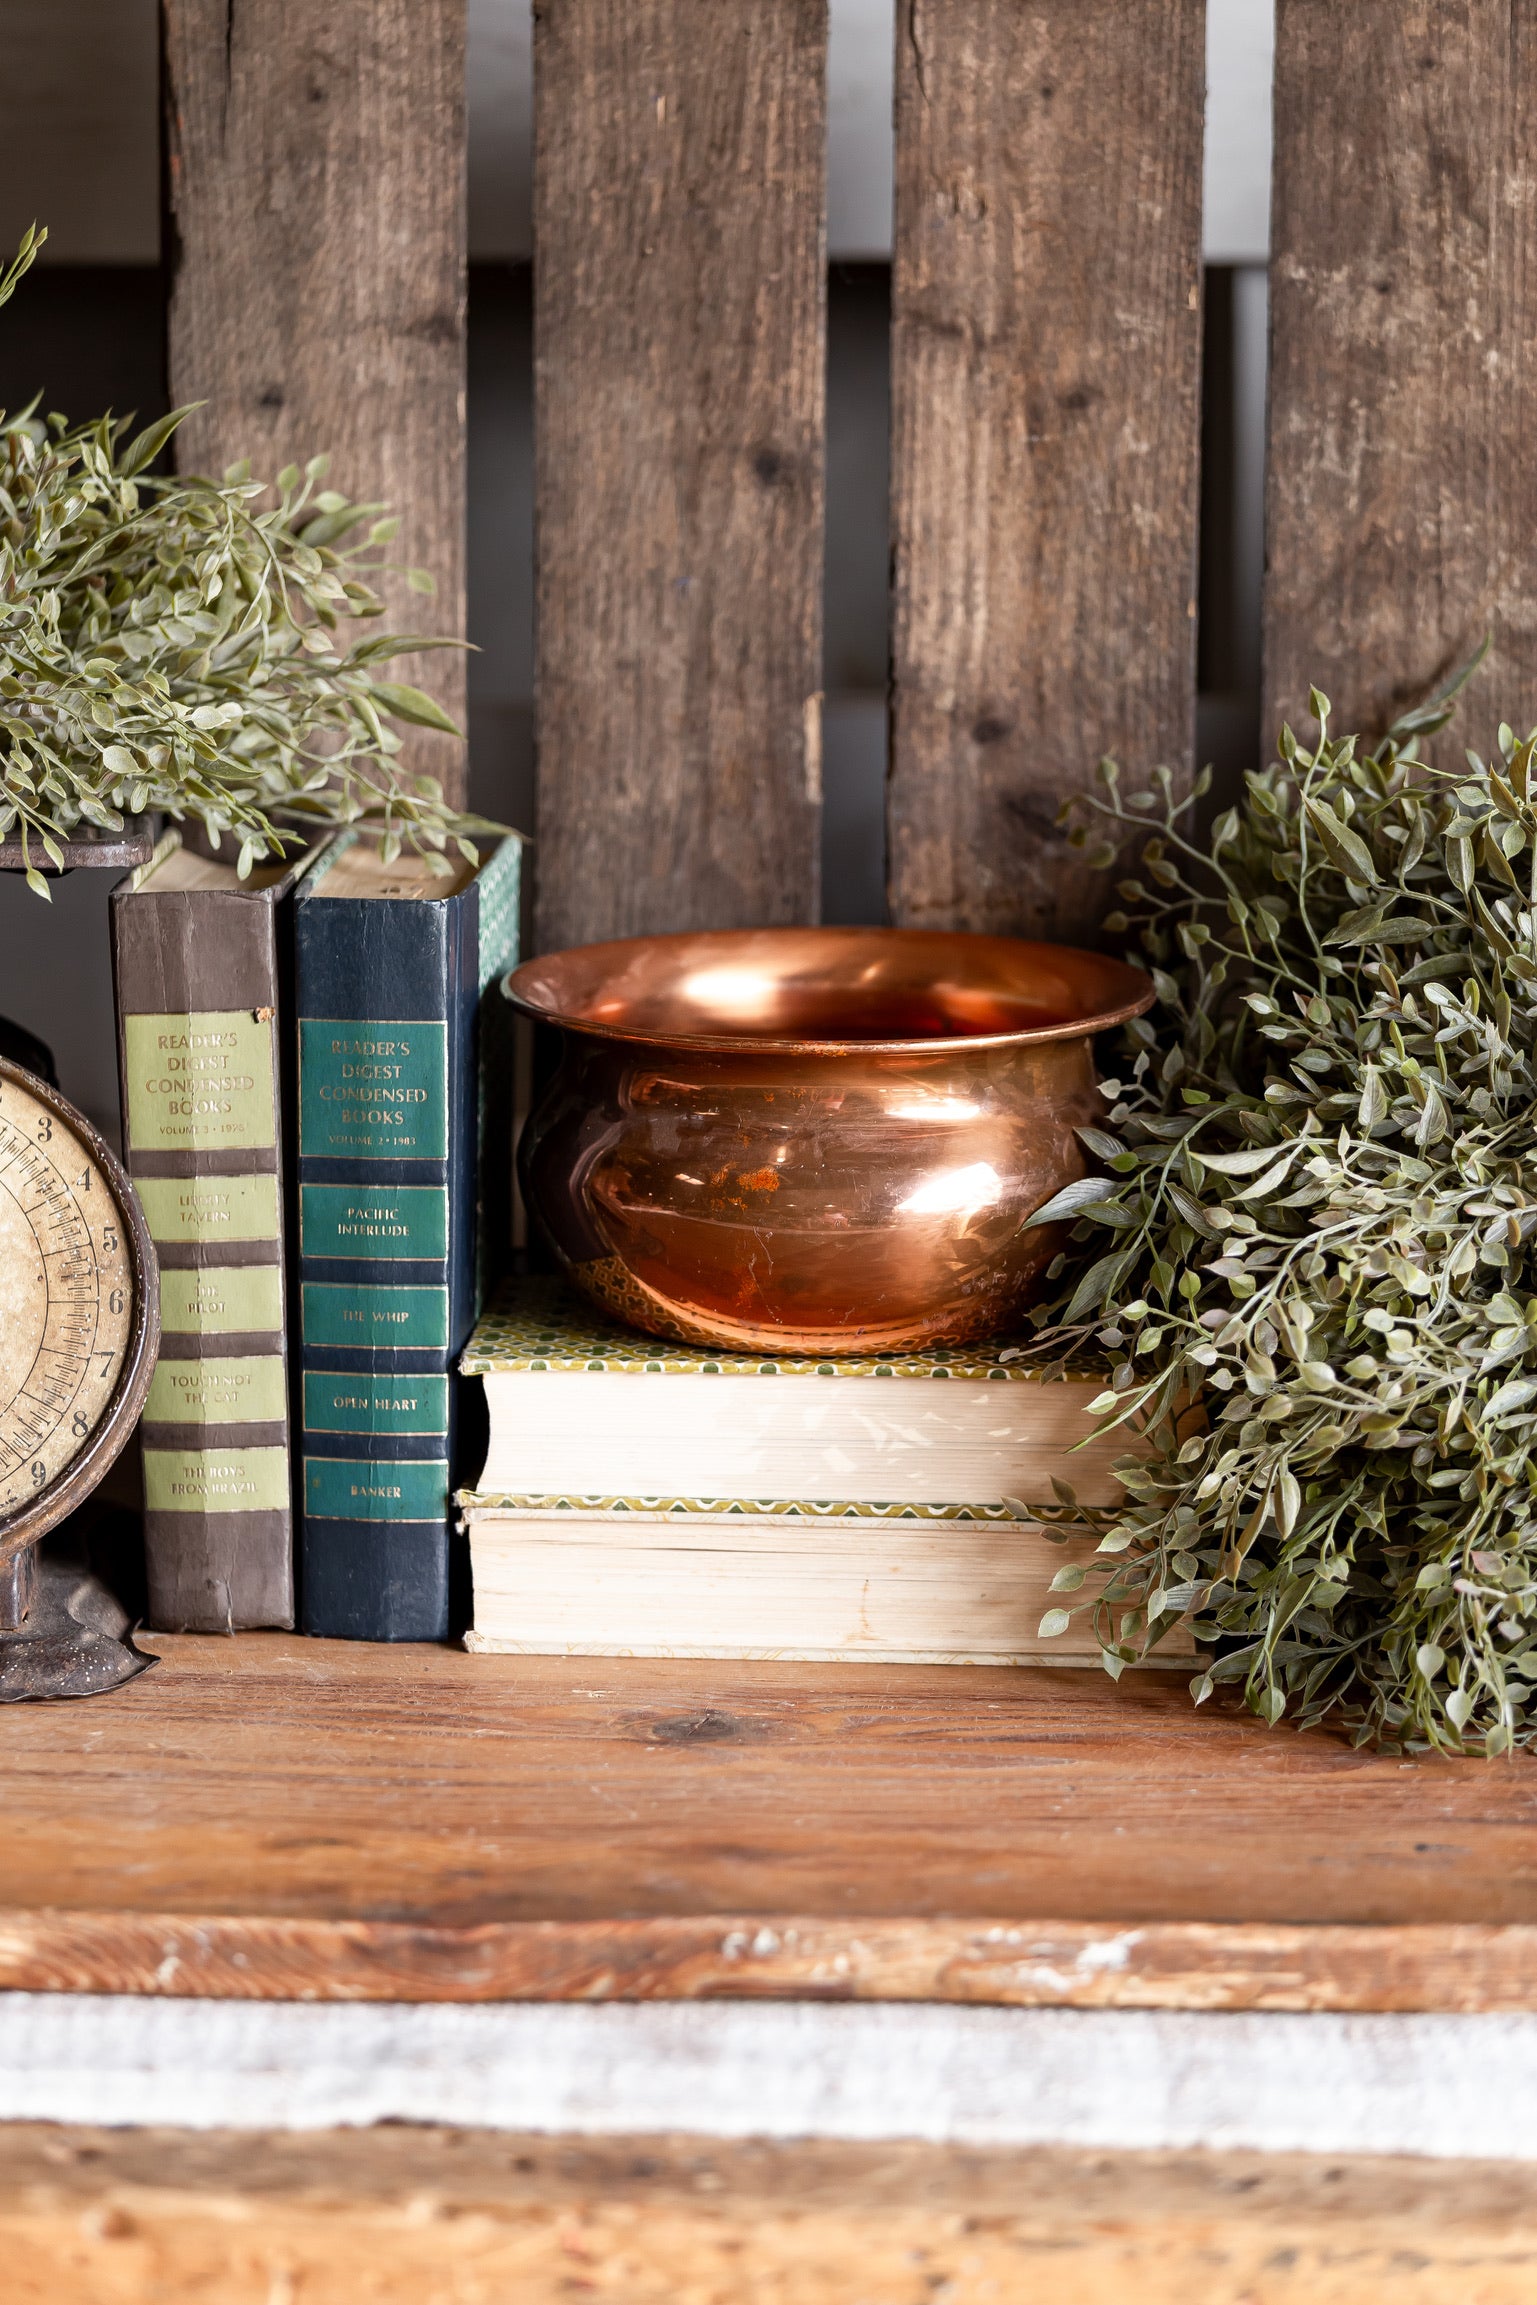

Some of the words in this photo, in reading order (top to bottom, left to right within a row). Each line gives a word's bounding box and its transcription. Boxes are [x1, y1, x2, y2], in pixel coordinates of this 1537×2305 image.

[158, 1032, 238, 1049] READER'S
[331, 1040, 413, 1056] READER'S
[167, 1055, 229, 1071] DIGEST
[342, 1063, 402, 1079] DIGEST
[145, 1076, 254, 1094] CONDENSED
[319, 1085, 428, 1103] CONDENSED
[168, 1099, 232, 1115] BOOKS
[341, 1108, 404, 1125] BOOKS
[36, 1115, 53, 1143] 3
[328, 1134, 372, 1145] VOLUME
[378, 1136, 384, 1146] 2
[393, 1136, 417, 1146] 1983
[75, 1165, 93, 1192] 4
[347, 1207, 399, 1220] PACIFIC
[338, 1223, 410, 1236] INTERLUDE
[102, 1226, 119, 1253] 5
[109, 1287, 125, 1316] 6
[342, 1309, 365, 1321] THE
[371, 1311, 411, 1323] WHIP
[97, 1350, 117, 1378] 7
[333, 1396, 369, 1409] OPEN
[375, 1398, 418, 1411] HEART
[71, 1410, 90, 1438] 8
[31, 1460, 47, 1488] 9
[351, 1485, 402, 1498] BANKER
